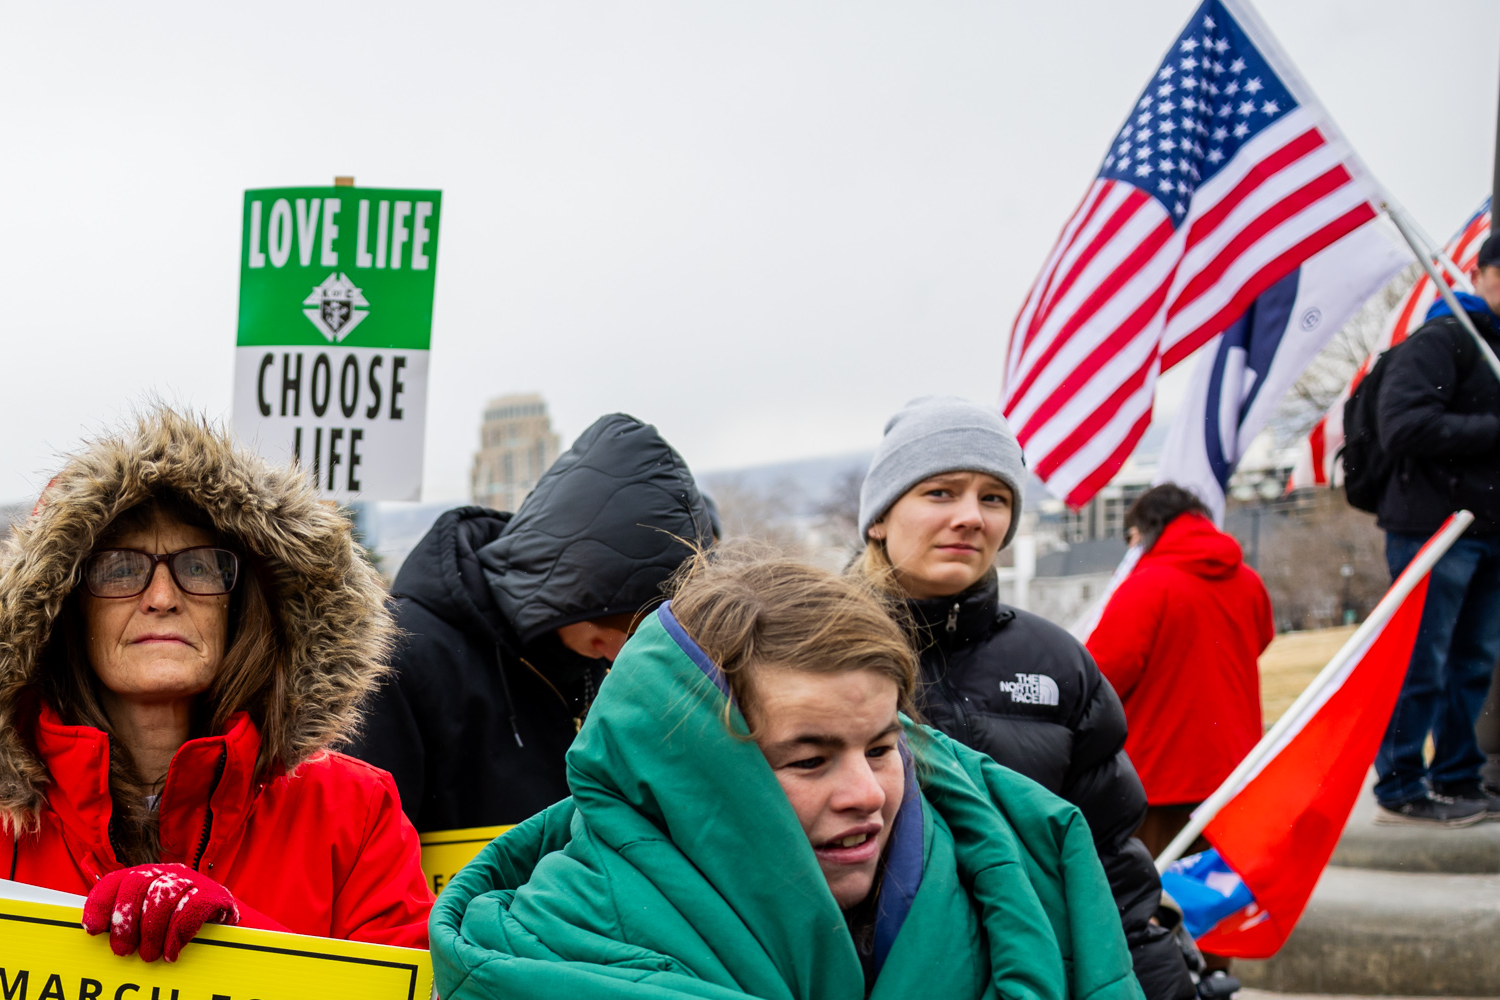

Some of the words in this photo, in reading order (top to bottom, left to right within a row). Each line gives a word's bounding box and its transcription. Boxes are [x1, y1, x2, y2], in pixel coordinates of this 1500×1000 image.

[249, 198, 341, 268] LOVE
[356, 199, 433, 270] LIFE
[257, 353, 407, 420] CHOOSE
[1015, 673, 1039, 684] THE
[999, 680, 1039, 694] NORTH
[1011, 691, 1040, 704] FACE
